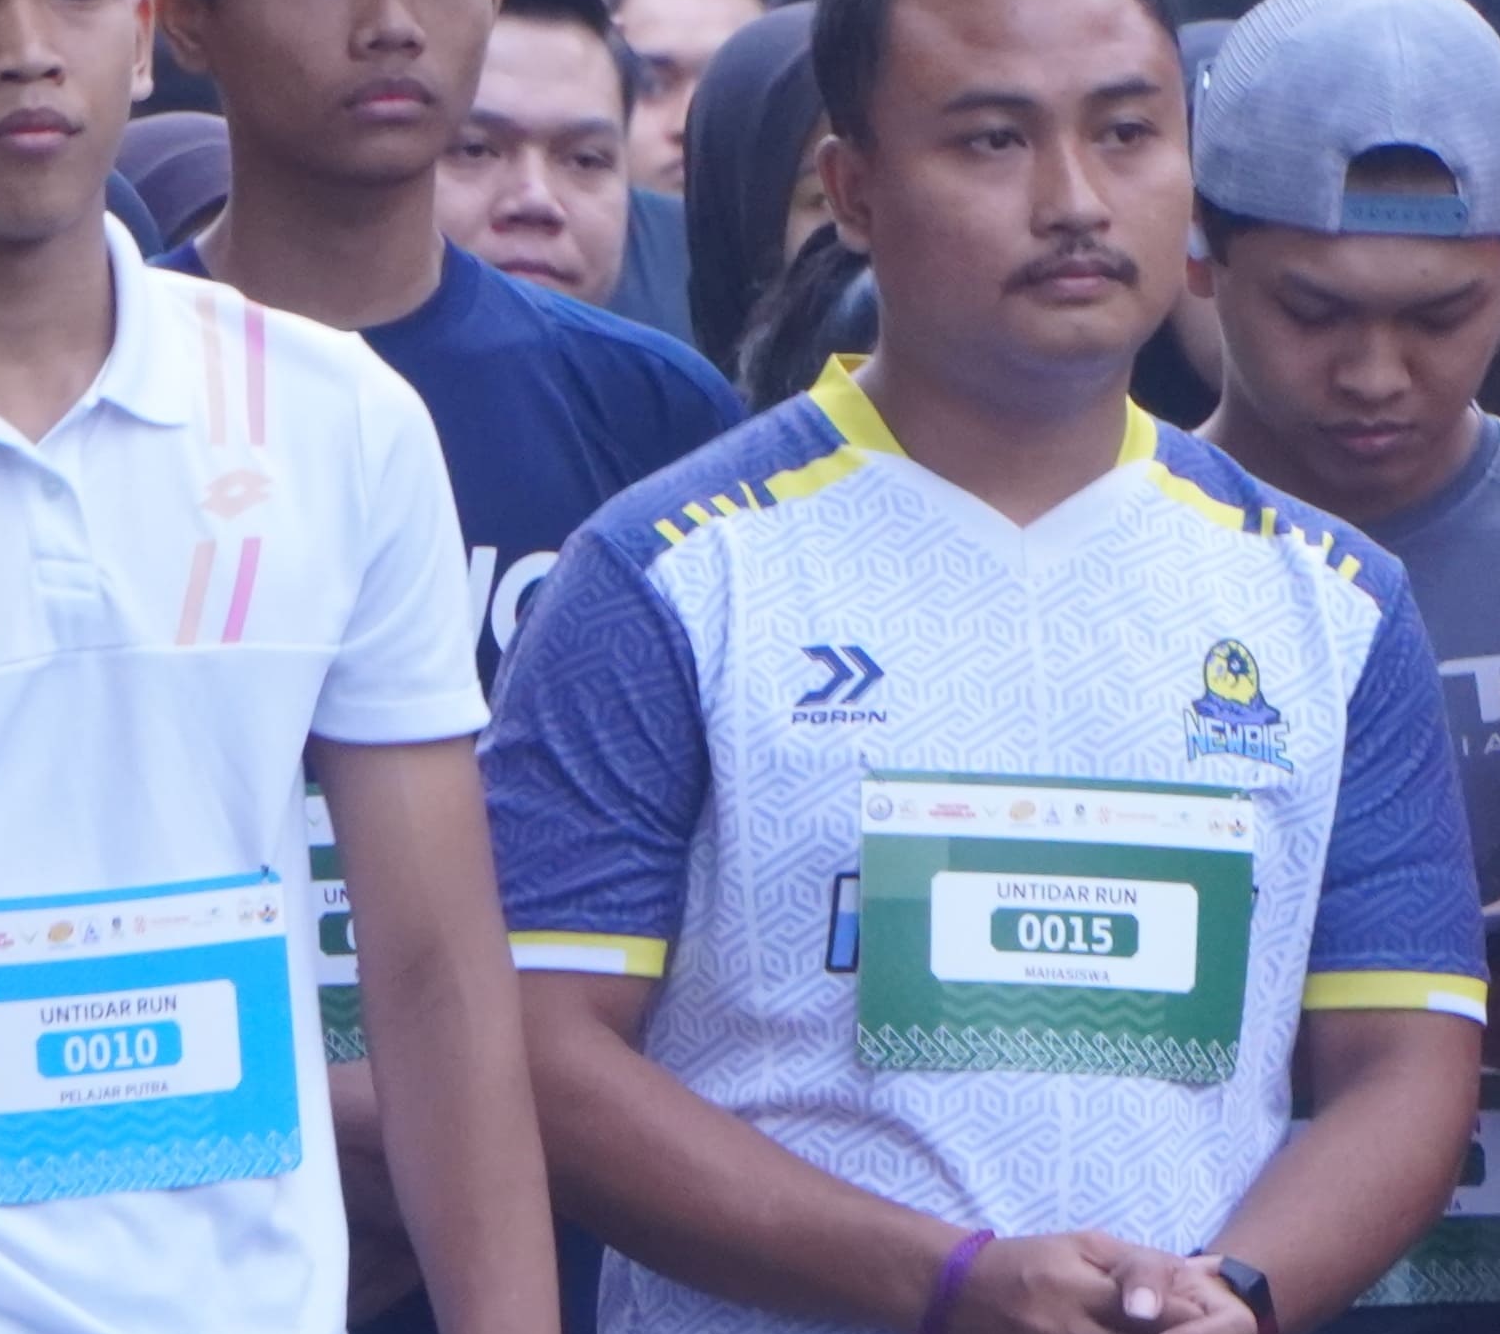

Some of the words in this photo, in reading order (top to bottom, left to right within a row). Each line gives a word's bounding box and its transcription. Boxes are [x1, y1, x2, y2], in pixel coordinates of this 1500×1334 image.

[1182, 706, 1294, 775] NEWBIE
[997, 881, 1089, 903] UNTIDAR
[1096, 887, 1138, 905] RUN
[1018, 913, 1114, 954] 0015
[1025, 966, 1110, 983] MAHASISWA
[39, 997, 132, 1025] UNTIDAR
[136, 994, 178, 1015] RUN
[63, 1028, 158, 1073] 0010
[60, 1085, 121, 1104] PELAJAR
[125, 1080, 169, 1100] PUTRA
